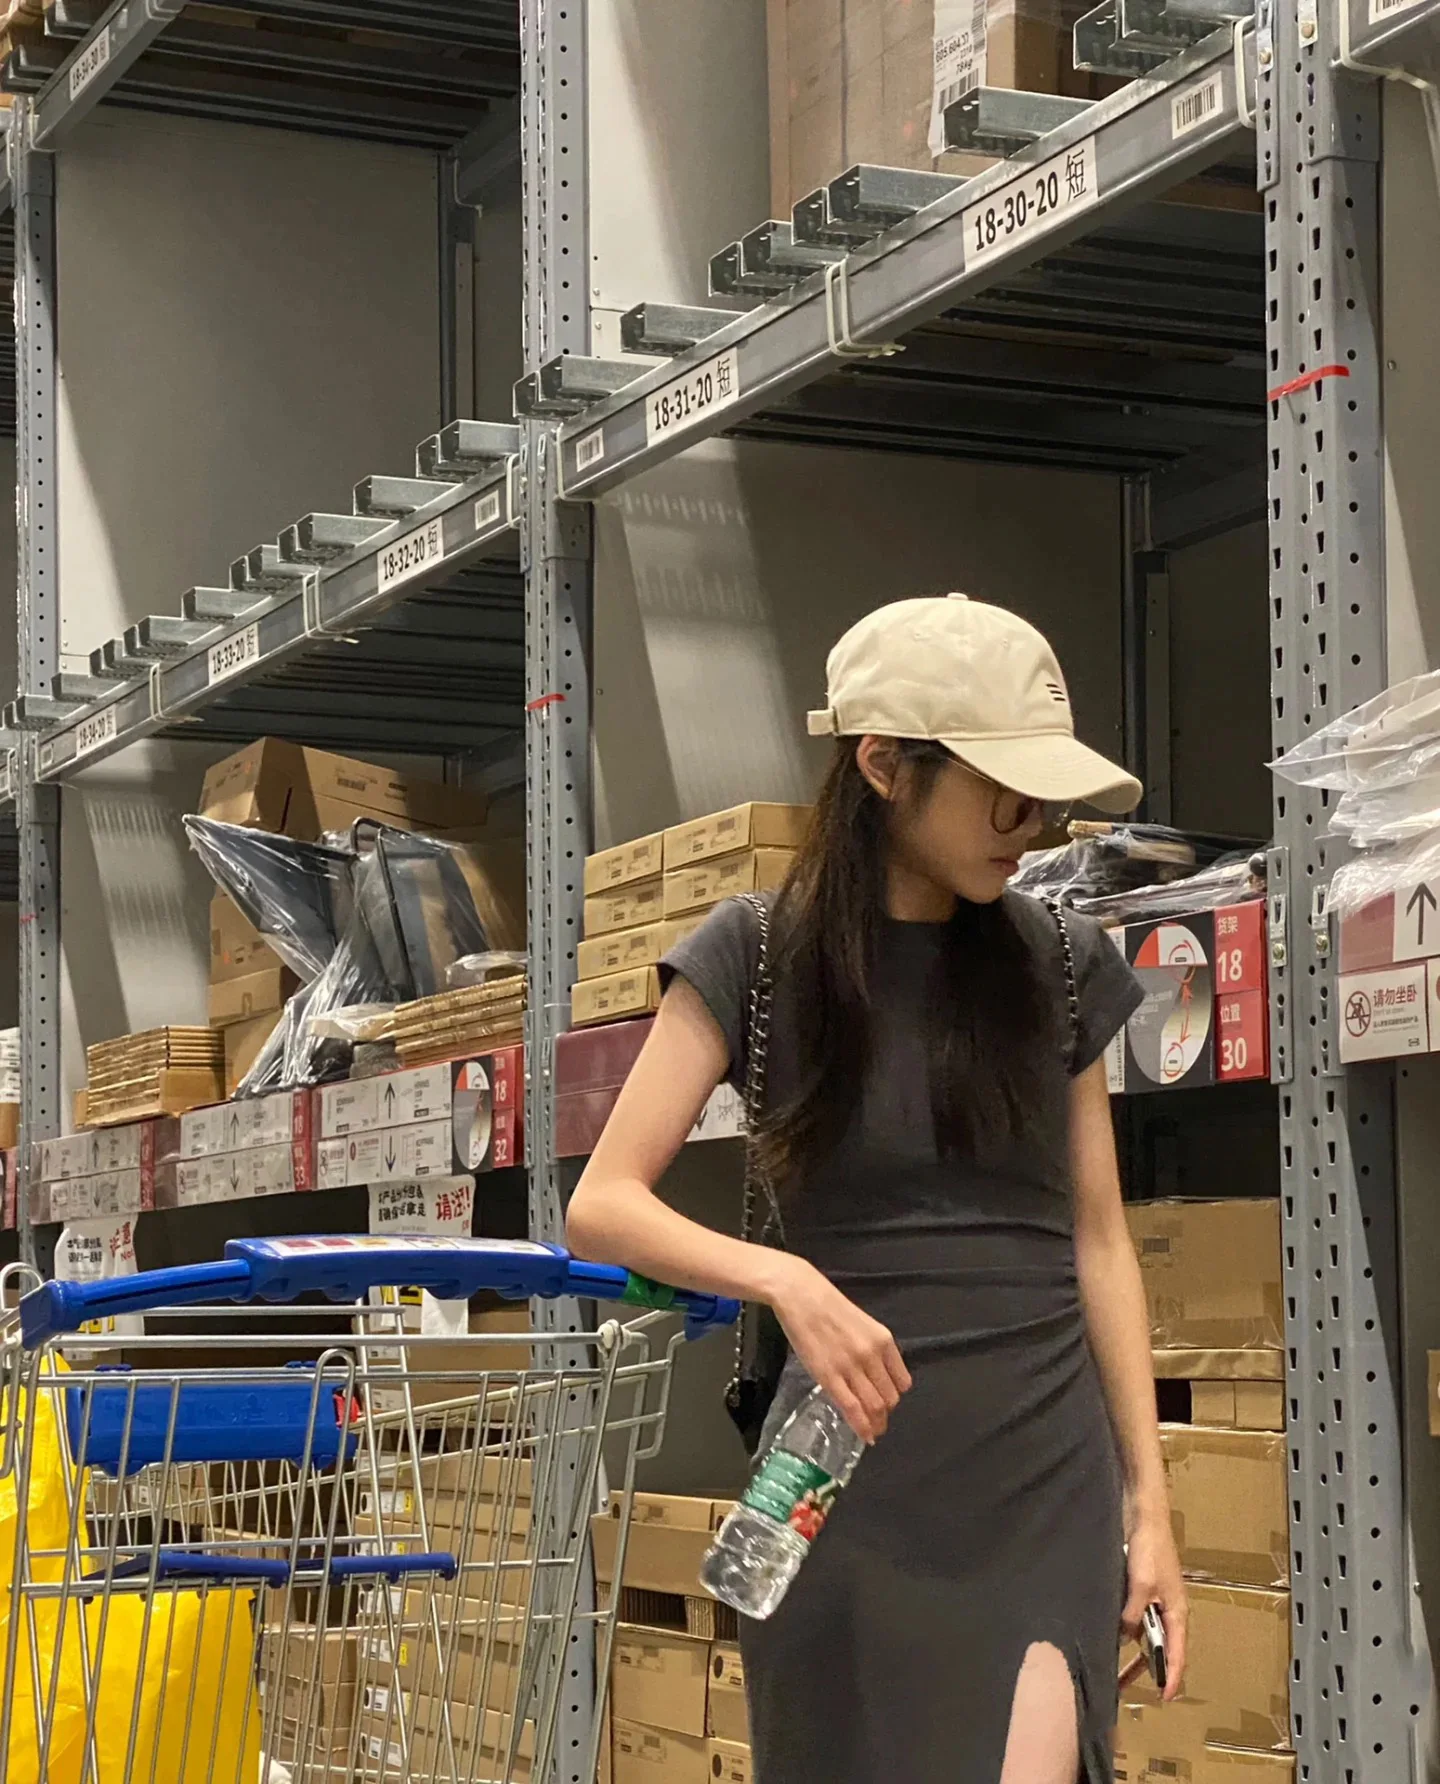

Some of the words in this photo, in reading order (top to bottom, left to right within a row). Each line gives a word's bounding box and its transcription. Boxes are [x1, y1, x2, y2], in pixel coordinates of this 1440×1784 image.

[975, 171, 1058, 251] 18-30-20
[1065, 149, 1087, 202] 短
[654, 372, 712, 431] 18-31-20
[717, 357, 732, 400] 短
[383, 535, 425, 580] 18-32-20
[212, 637, 245, 675] 18-33-20
[1218, 915, 1238, 936] 货架
[1217, 948, 1243, 983] 18
[1373, 983, 1417, 1008] 请勿坐卧
[1220, 1003, 1241, 1024] 位置
[1221, 1037, 1247, 1072] 30
[494, 1080, 507, 1102] 18
[494, 1138, 507, 1162] 32
[295, 1166, 305, 1186] 33
